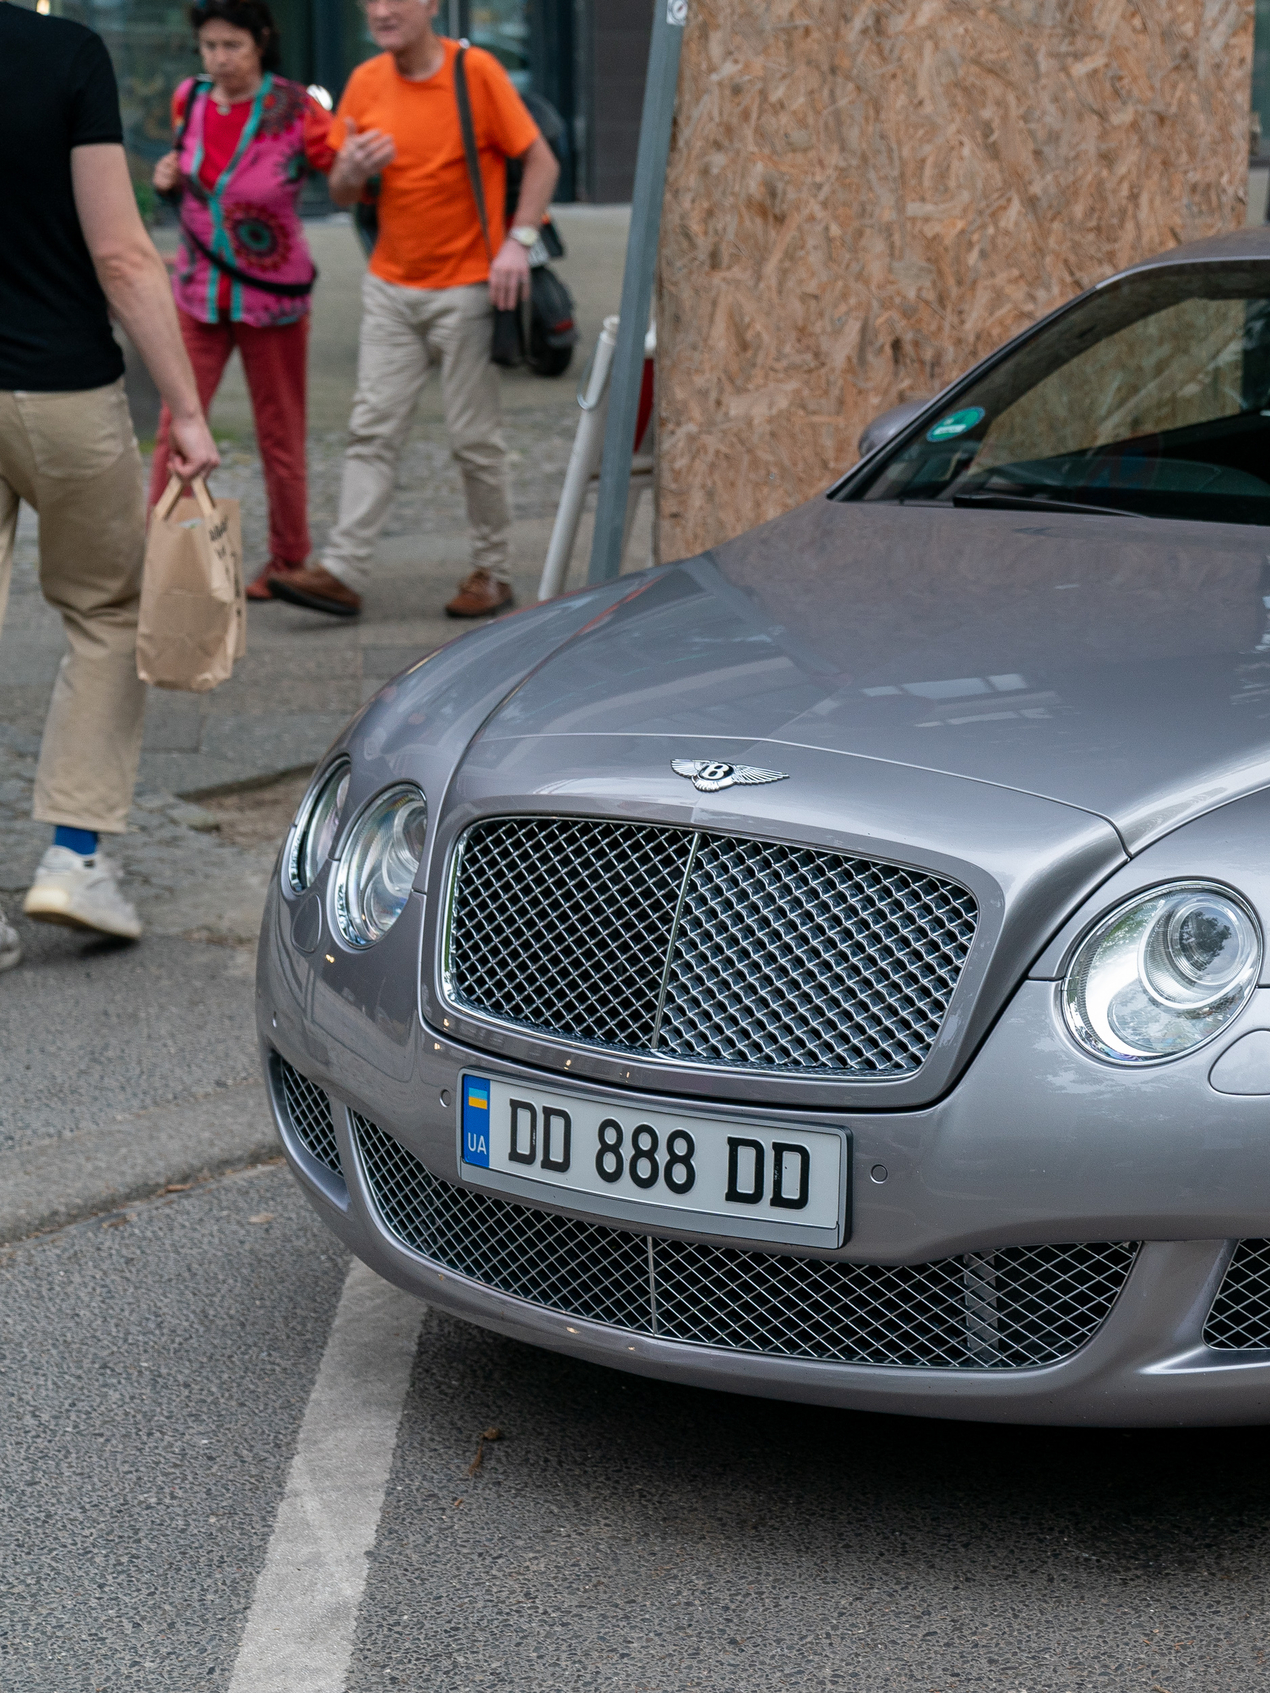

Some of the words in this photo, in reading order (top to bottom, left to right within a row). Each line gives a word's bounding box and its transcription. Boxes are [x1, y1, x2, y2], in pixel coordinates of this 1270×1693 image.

[467, 1132, 487, 1156] UA
[508, 1097, 572, 1173] DD
[595, 1116, 696, 1194] 888
[724, 1135, 811, 1210] DD
